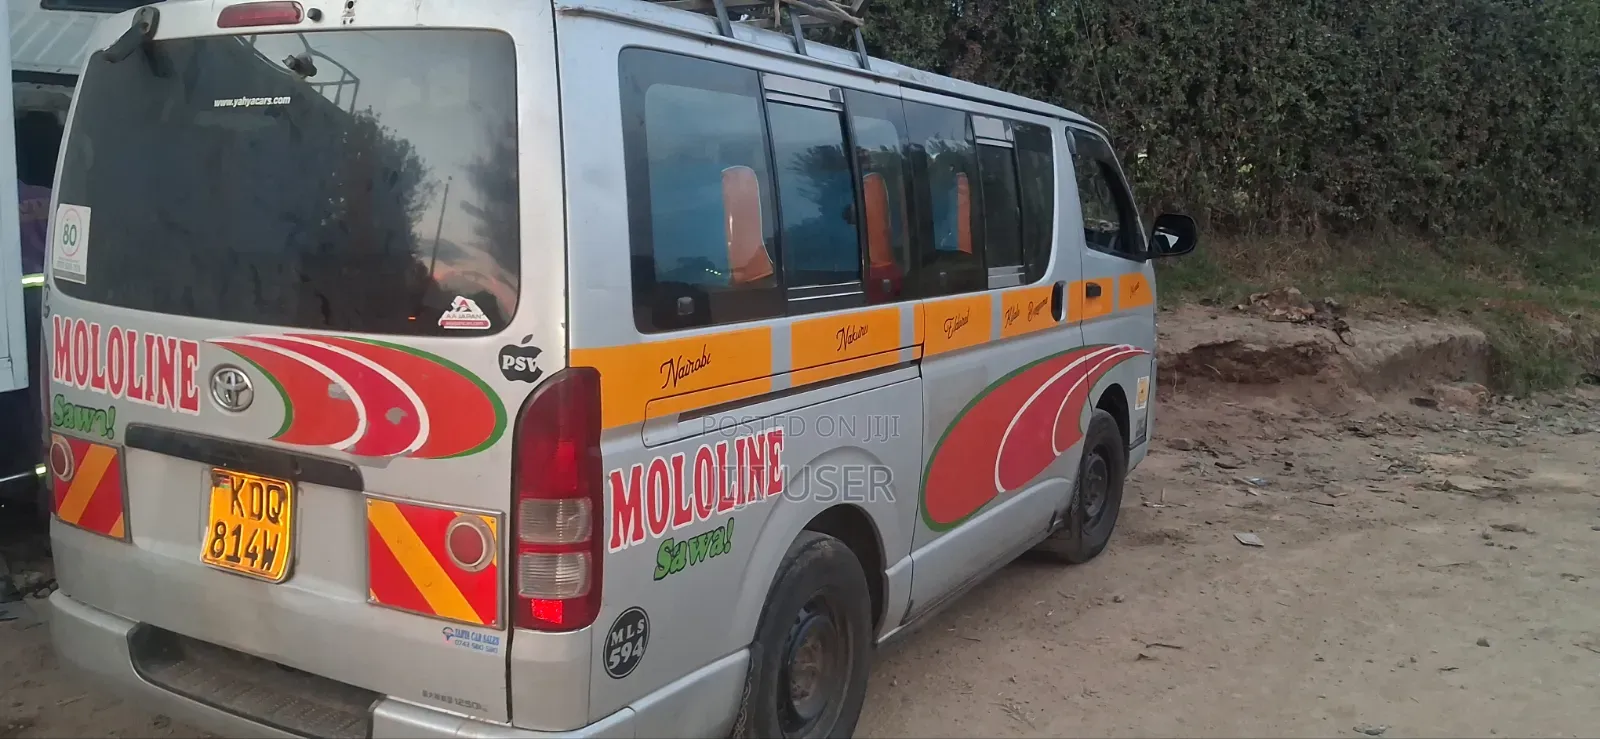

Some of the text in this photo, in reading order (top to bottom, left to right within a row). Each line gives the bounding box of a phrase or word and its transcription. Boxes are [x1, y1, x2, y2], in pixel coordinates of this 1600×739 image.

[214, 96, 291, 108] www.yahyacars.com
[62, 223, 78, 247] 80
[458, 313, 482, 321] JAPAN
[835, 323, 869, 353] Nakuru
[52, 314, 200, 416] MOLOLINE
[502, 354, 539, 373] PSV
[659, 343, 712, 389] Nairobi
[231, 476, 286, 525] KDQ
[608, 426, 784, 554] MOLOLINE
[210, 520, 281, 573] 814W
[653, 516, 735, 581] Sawa!
[608, 635, 644, 670] 594
